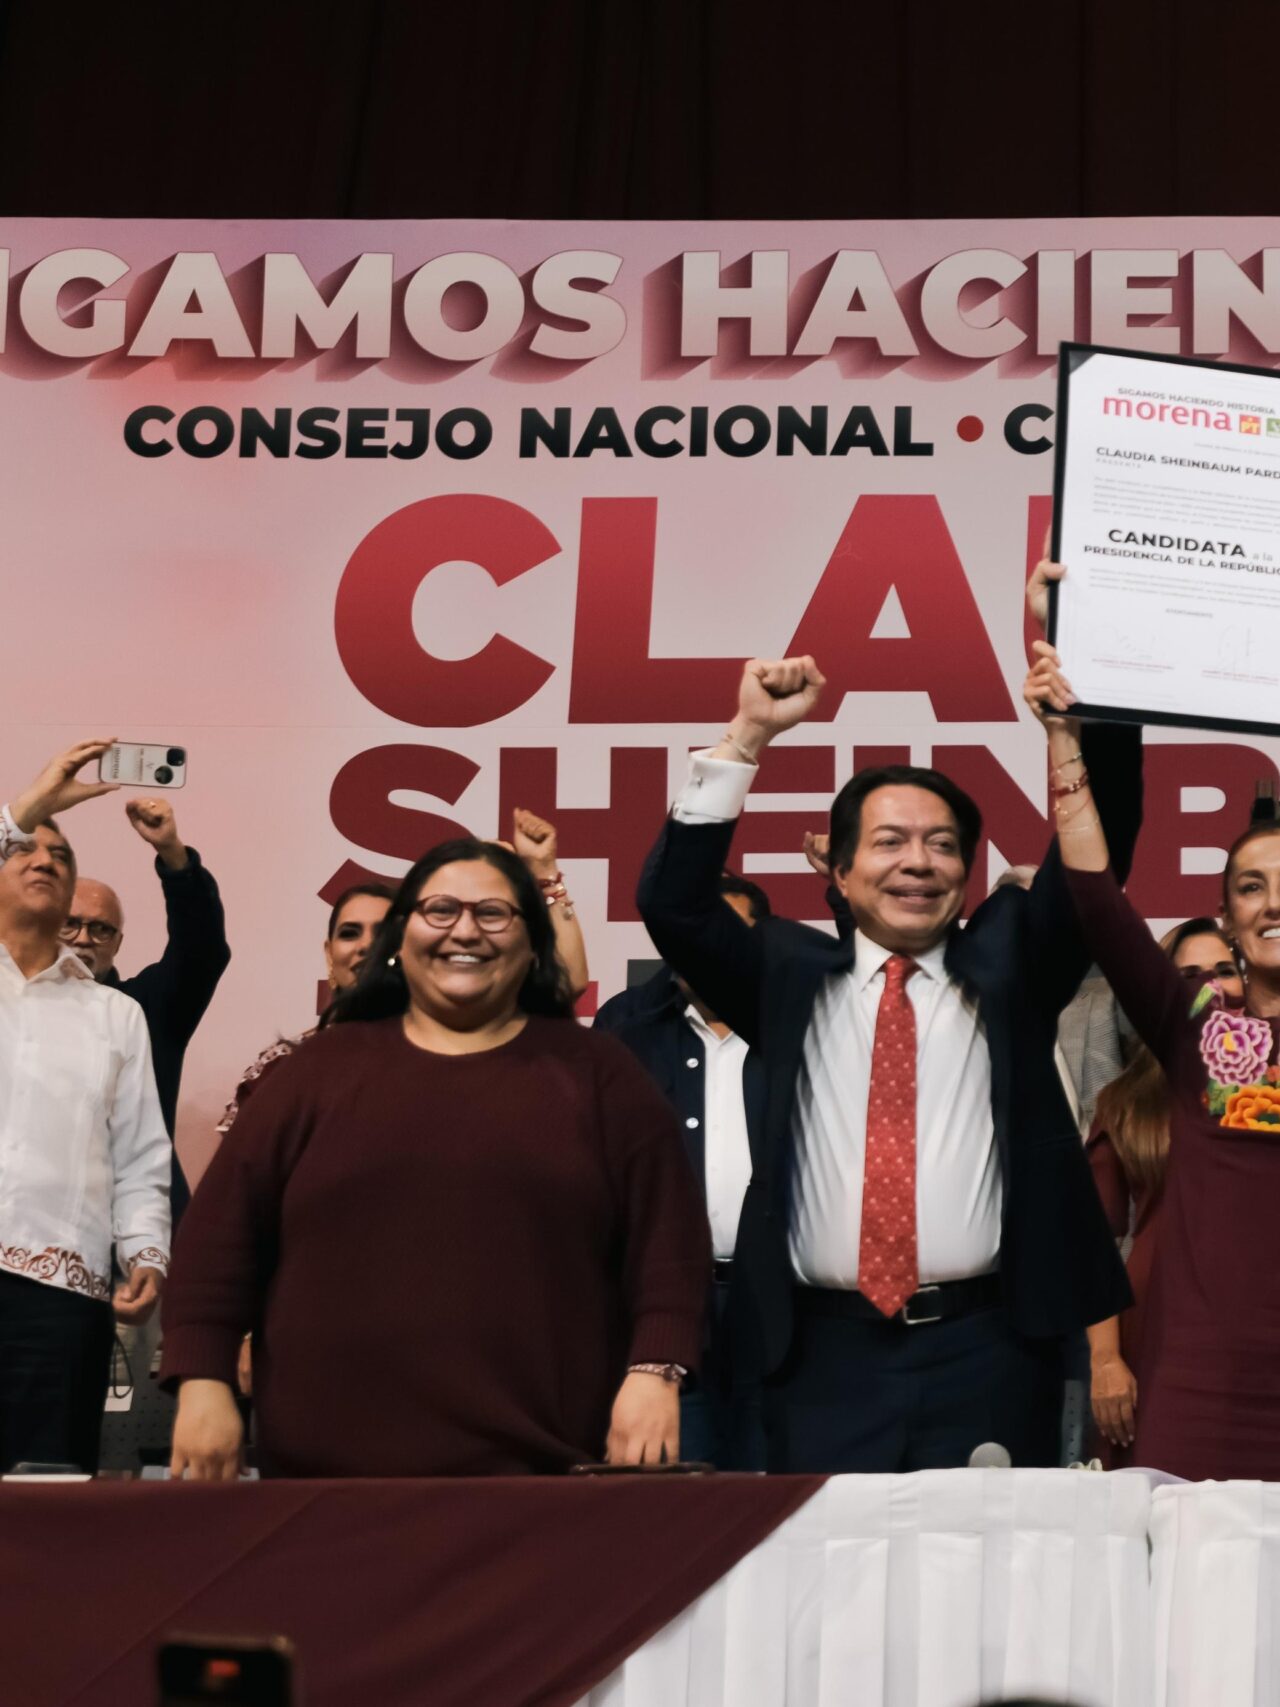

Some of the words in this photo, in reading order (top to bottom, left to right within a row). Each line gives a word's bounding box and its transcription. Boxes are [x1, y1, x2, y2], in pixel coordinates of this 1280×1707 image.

[0, 248, 628, 361] GAMOS
[1103, 396, 1232, 432] morena
[1118, 387, 1166, 401] SIGAMOS
[1169, 393, 1225, 408] HACIENDO
[1227, 401, 1276, 415] HISTORIA
[124, 406, 492, 460] CONSEJO
[520, 405, 934, 459] NACIONAL
[1240, 421, 1259, 434] PT
[1096, 447, 1157, 463] CLAUDIA
[1160, 455, 1242, 475] SHEINBAUM
[1083, 545, 1173, 563] PRESIDENCIA
[1177, 555, 1194, 566] DE
[1198, 558, 1216, 568] LA
[1108, 529, 1246, 558] CANDIDATA
